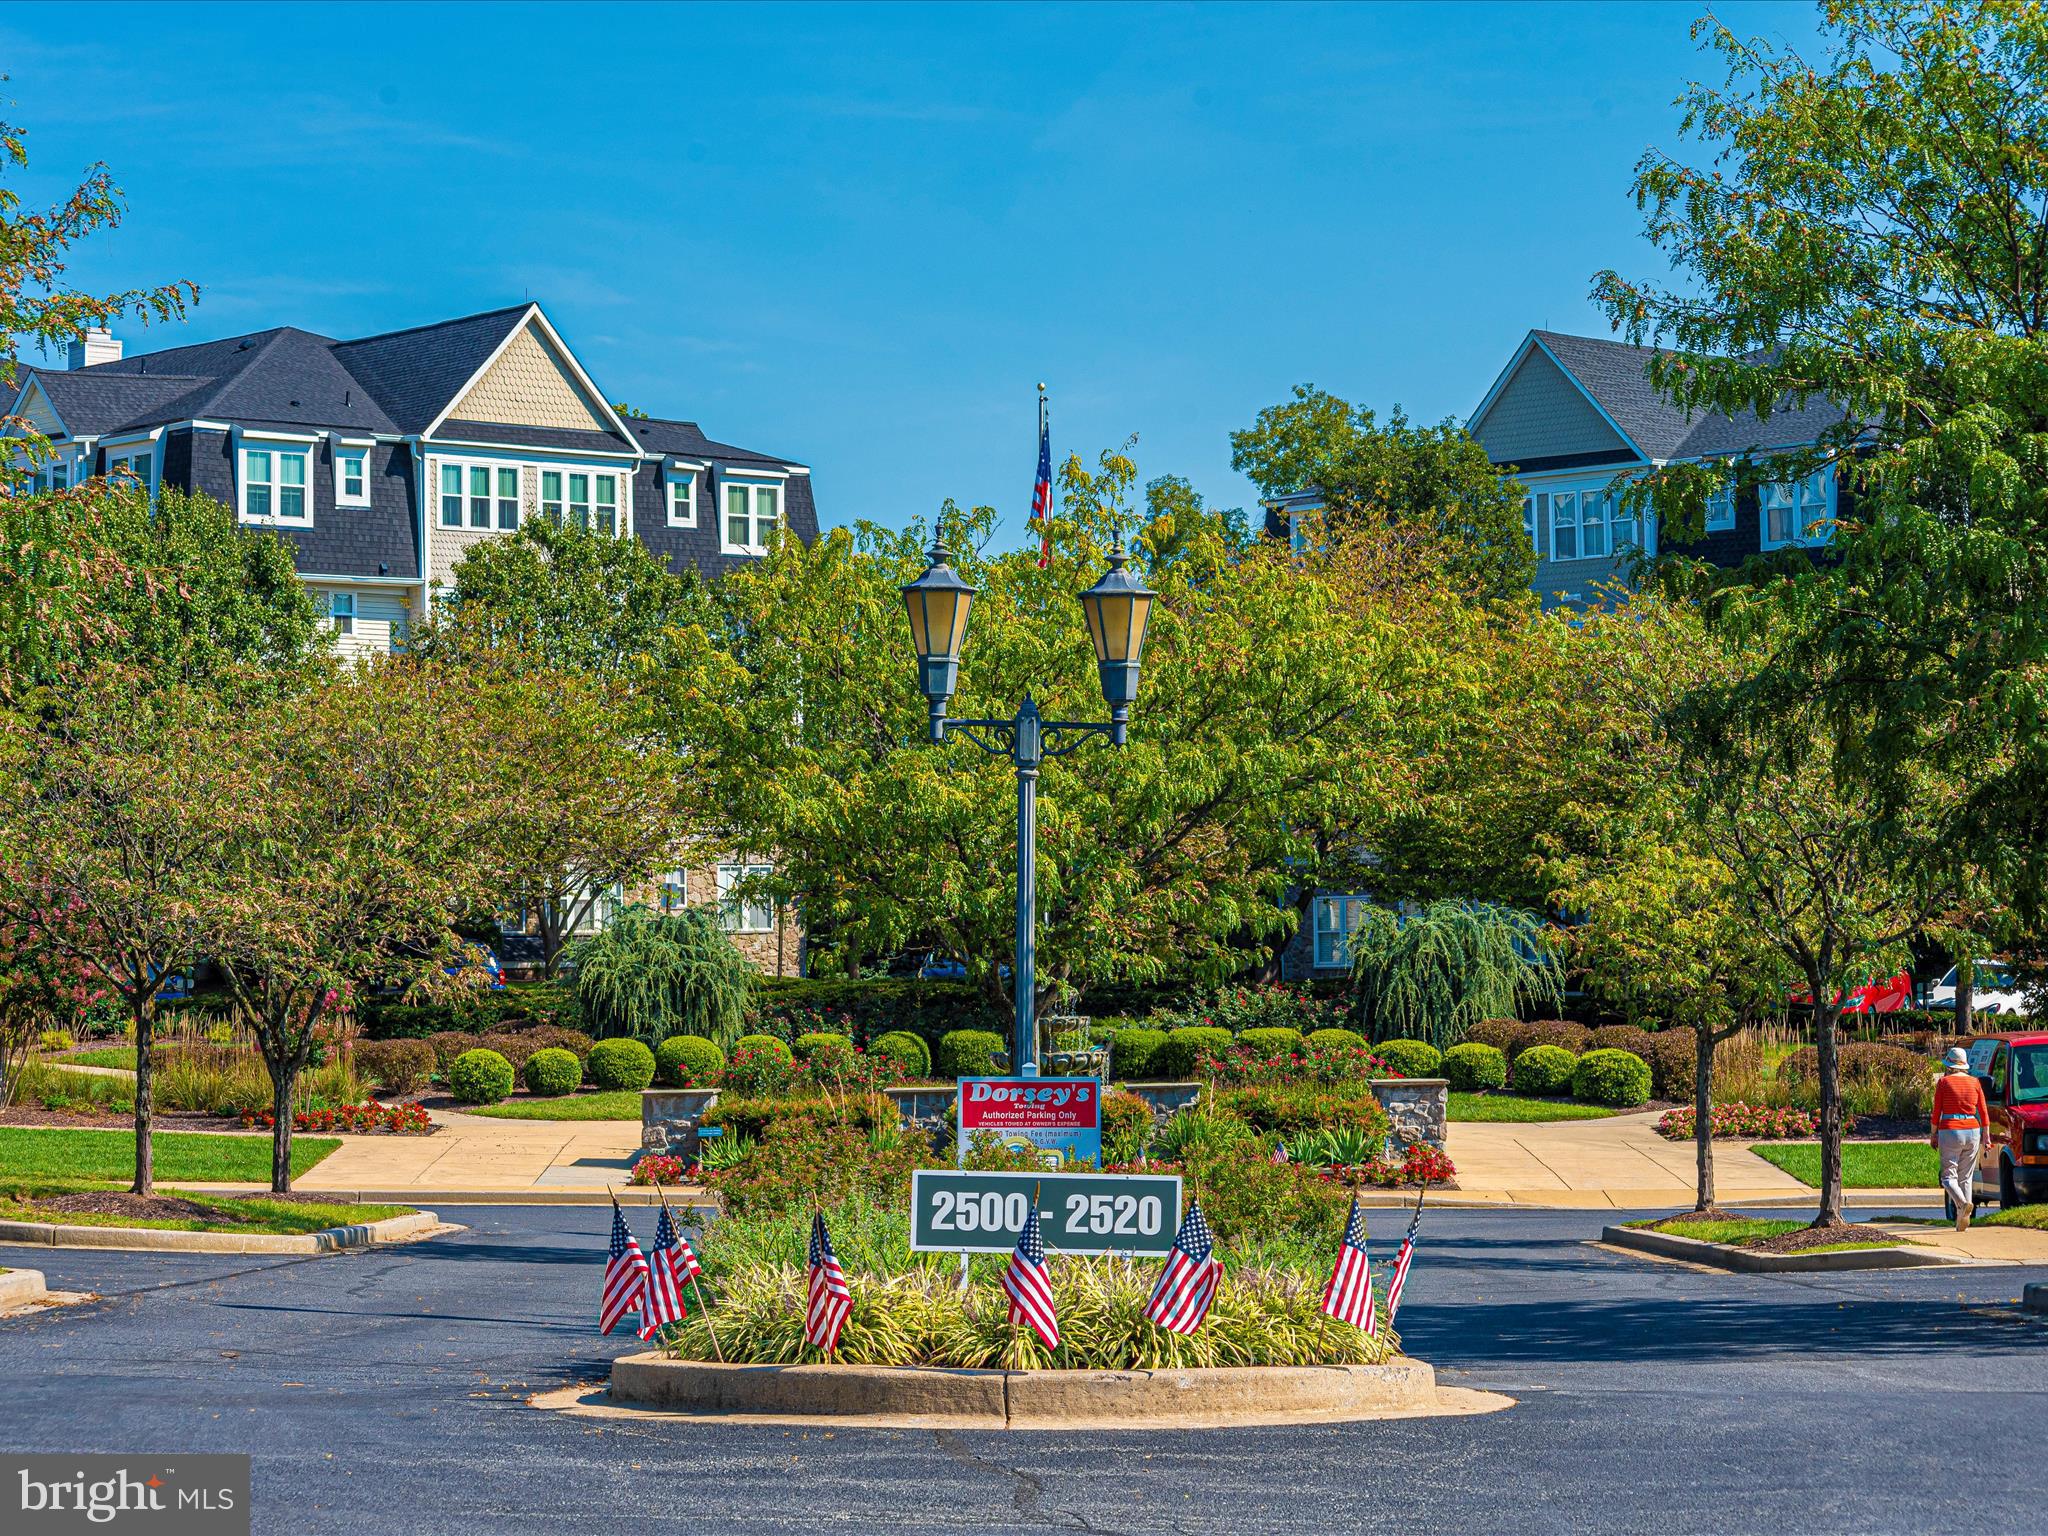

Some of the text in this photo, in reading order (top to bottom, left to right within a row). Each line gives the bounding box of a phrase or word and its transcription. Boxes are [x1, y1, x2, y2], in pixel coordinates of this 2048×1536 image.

[969, 1083, 1090, 1106] Dorsey's
[982, 1111, 1077, 1121] Authorized Parking Only
[1005, 1130, 1029, 1138] Towing
[1044, 1130, 1082, 1138] (maximum)
[931, 1191, 1028, 1232] 2500
[1065, 1194, 1162, 1235] 2520
